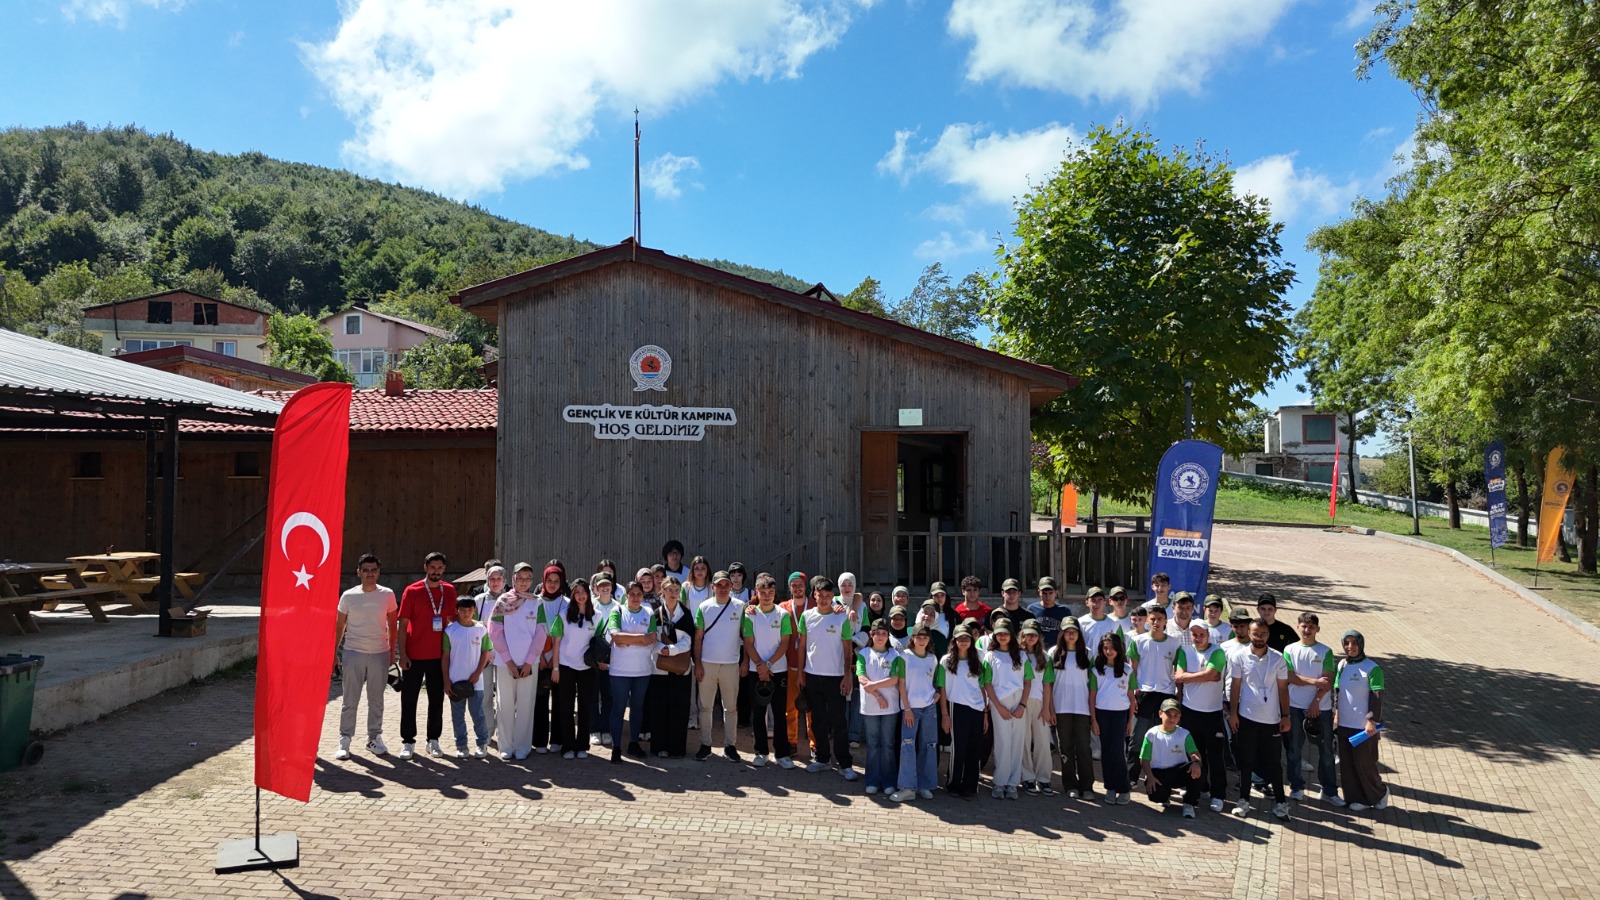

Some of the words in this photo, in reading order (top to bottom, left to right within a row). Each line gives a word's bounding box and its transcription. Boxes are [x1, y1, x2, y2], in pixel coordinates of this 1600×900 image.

[567, 407, 616, 421] GENÇLİK
[618, 409, 633, 420] VE
[634, 408, 679, 421] KÜLTÜR
[681, 411, 733, 422] KAMPINA
[599, 423, 630, 437] HOŞ
[1159, 538, 1204, 549] GURURLA
[1161, 548, 1201, 559] SAMSUN
